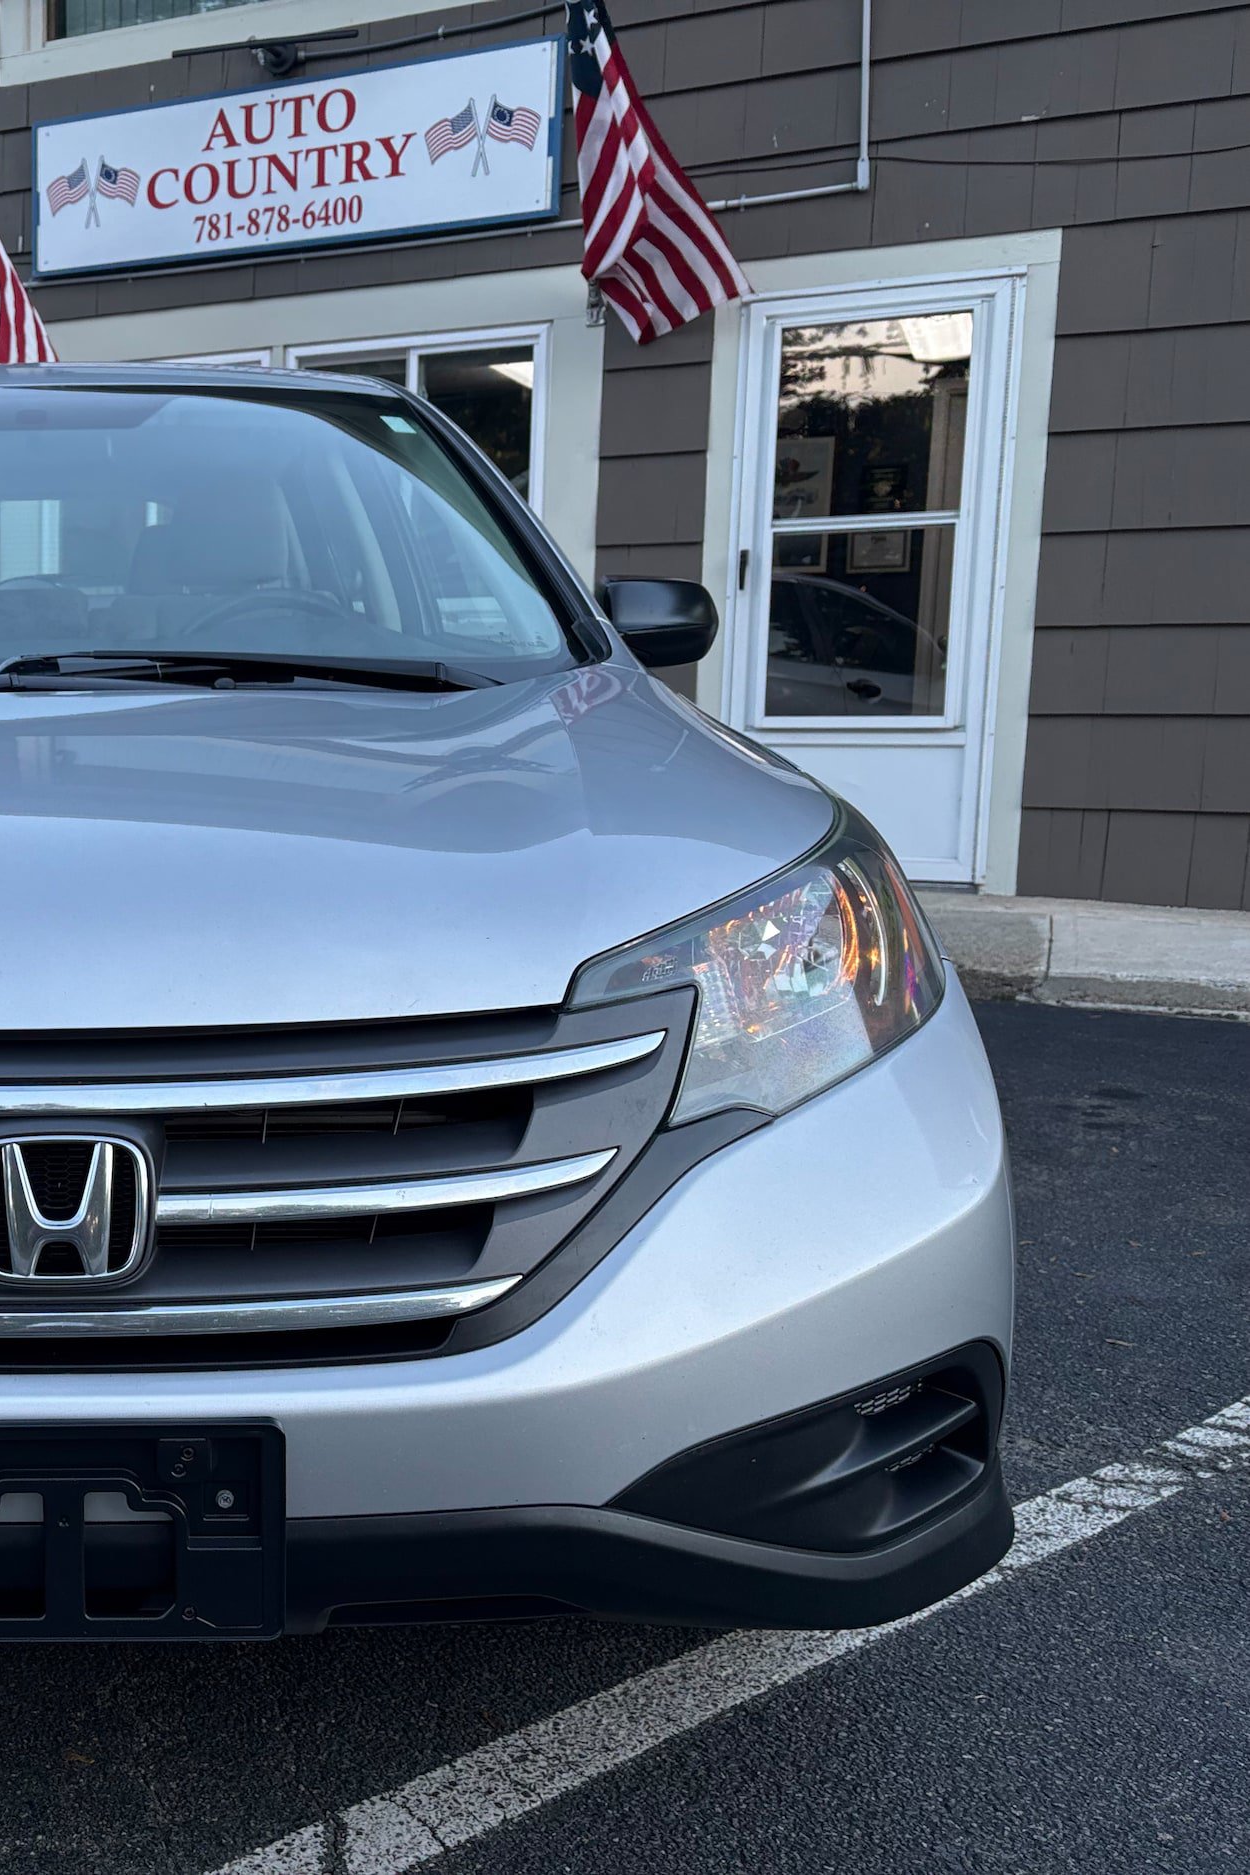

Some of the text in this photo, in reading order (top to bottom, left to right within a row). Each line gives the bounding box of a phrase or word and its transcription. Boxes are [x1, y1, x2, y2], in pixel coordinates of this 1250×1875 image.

[202, 88, 357, 152] AUTO
[147, 132, 417, 209] COUNTRY
[193, 195, 363, 243] 781-878-6400
